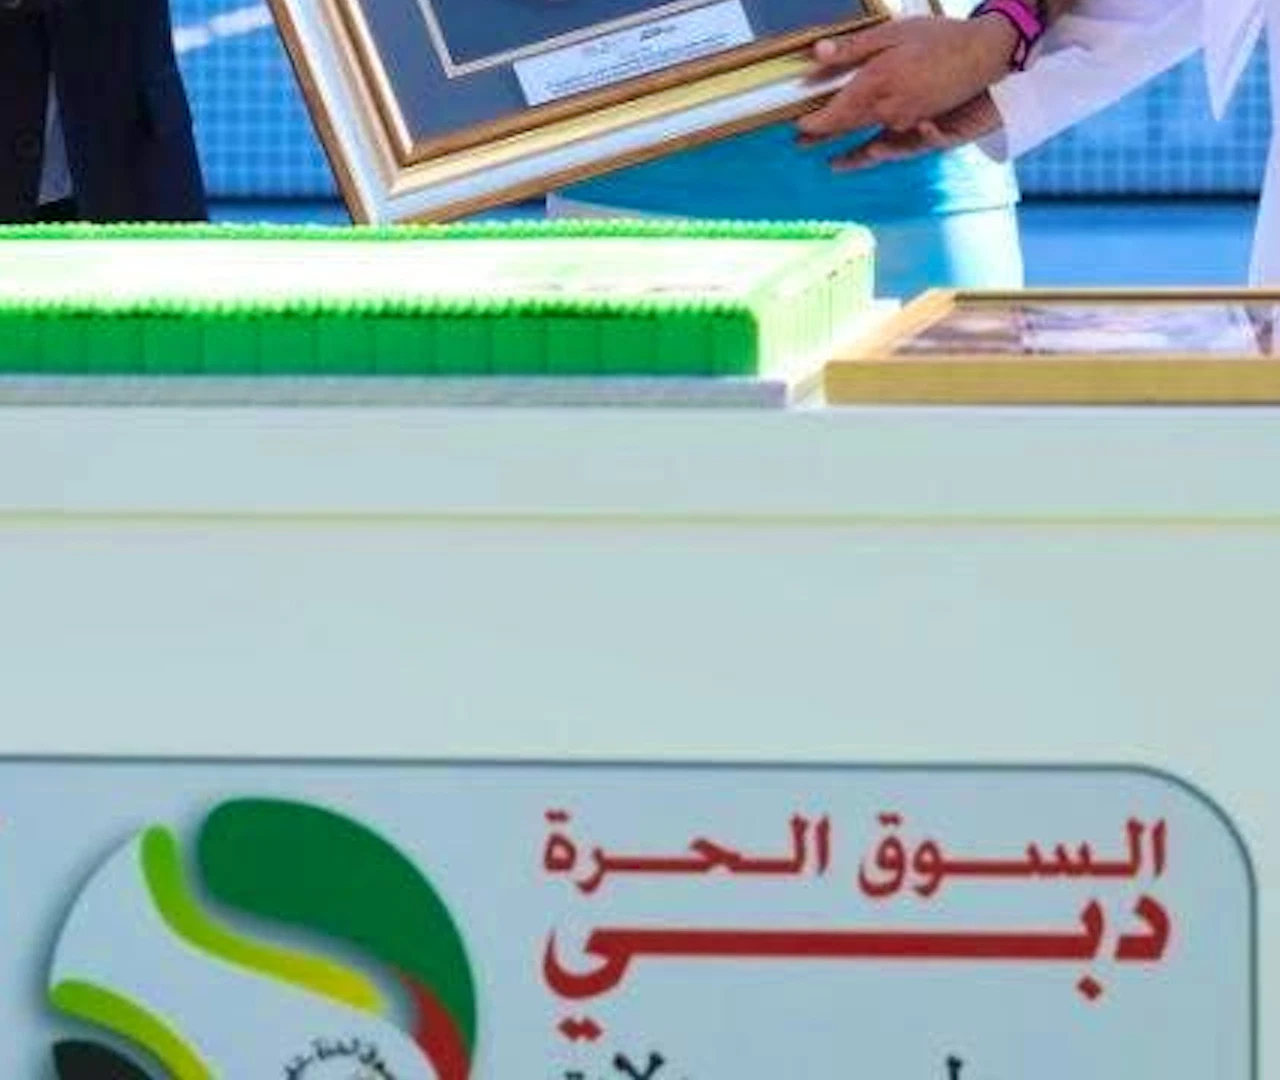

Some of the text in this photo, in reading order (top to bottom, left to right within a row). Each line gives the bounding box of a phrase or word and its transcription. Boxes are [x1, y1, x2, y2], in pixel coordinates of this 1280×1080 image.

[544, 808, 1168, 899] السوق الحرة
[542, 894, 1171, 1044] دبي
